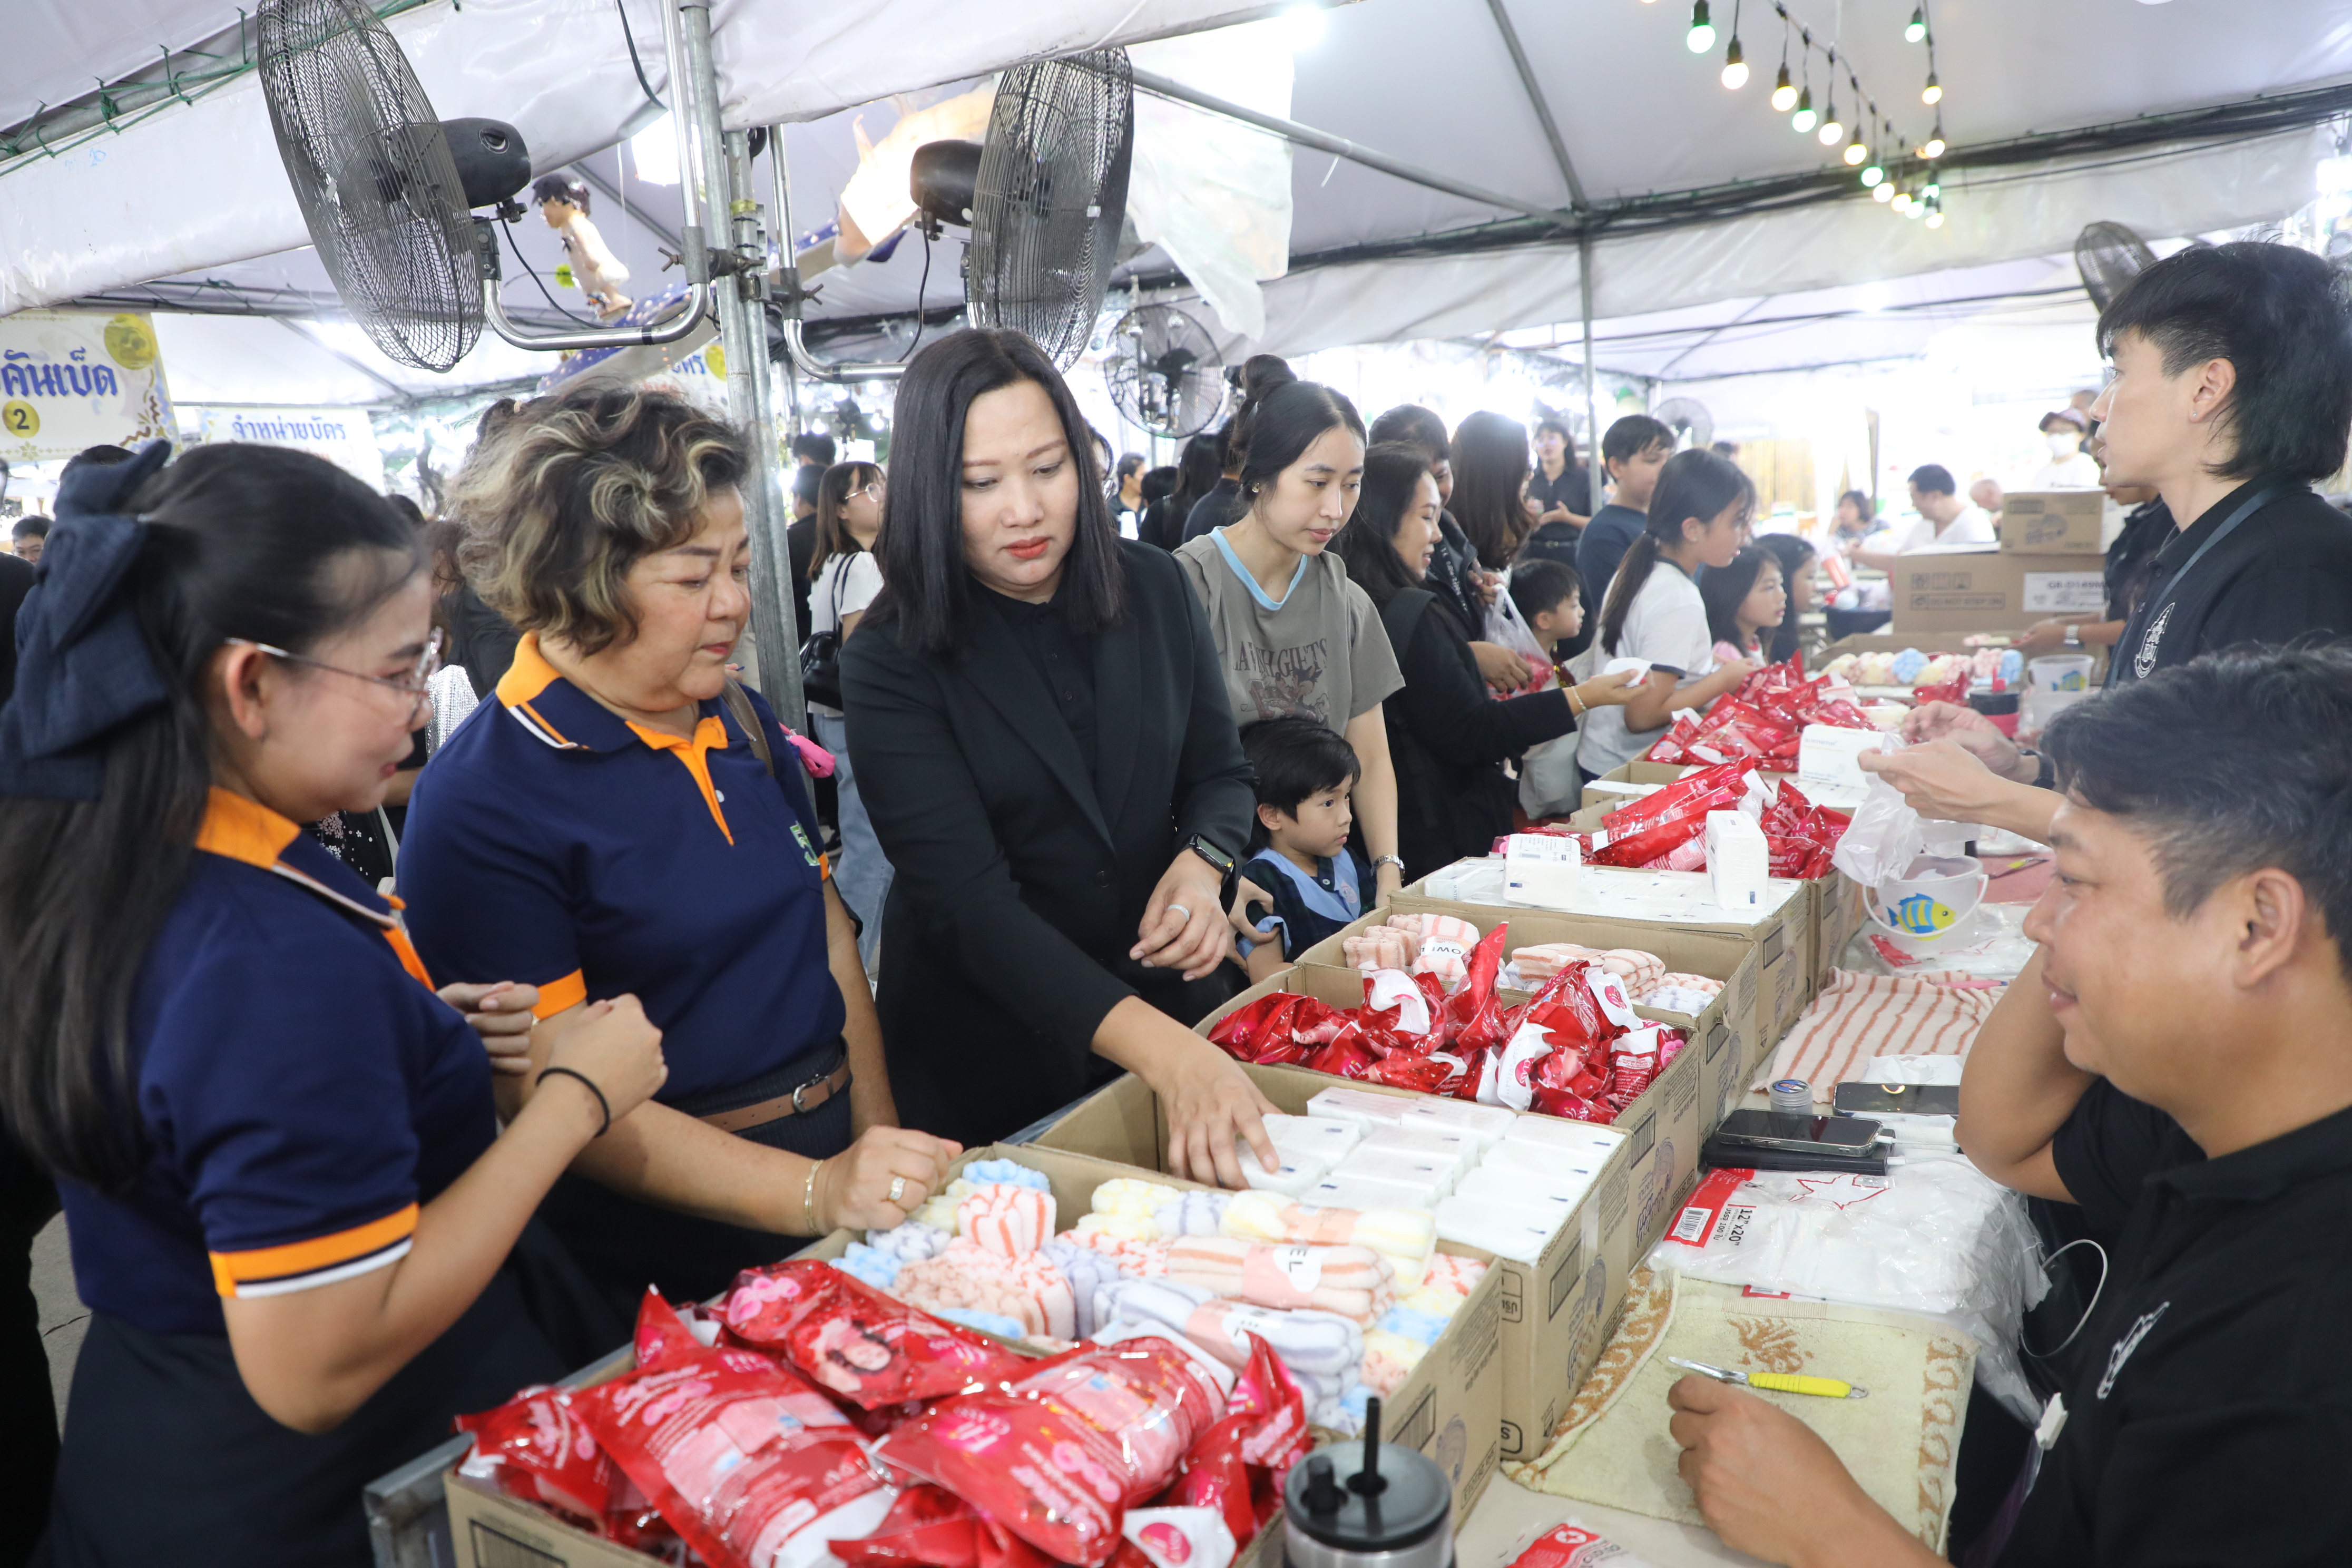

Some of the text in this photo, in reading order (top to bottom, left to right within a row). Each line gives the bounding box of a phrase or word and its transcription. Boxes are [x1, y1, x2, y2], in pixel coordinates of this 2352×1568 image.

[13, 408, 30, 430] 2
[232, 414, 346, 440] จำหน่ายบัตร
[1521, 1061, 1531, 1087] CLASS
[1720, 1208, 1732, 1220] บรรจุ
[1717, 1222, 1727, 1233] 100
